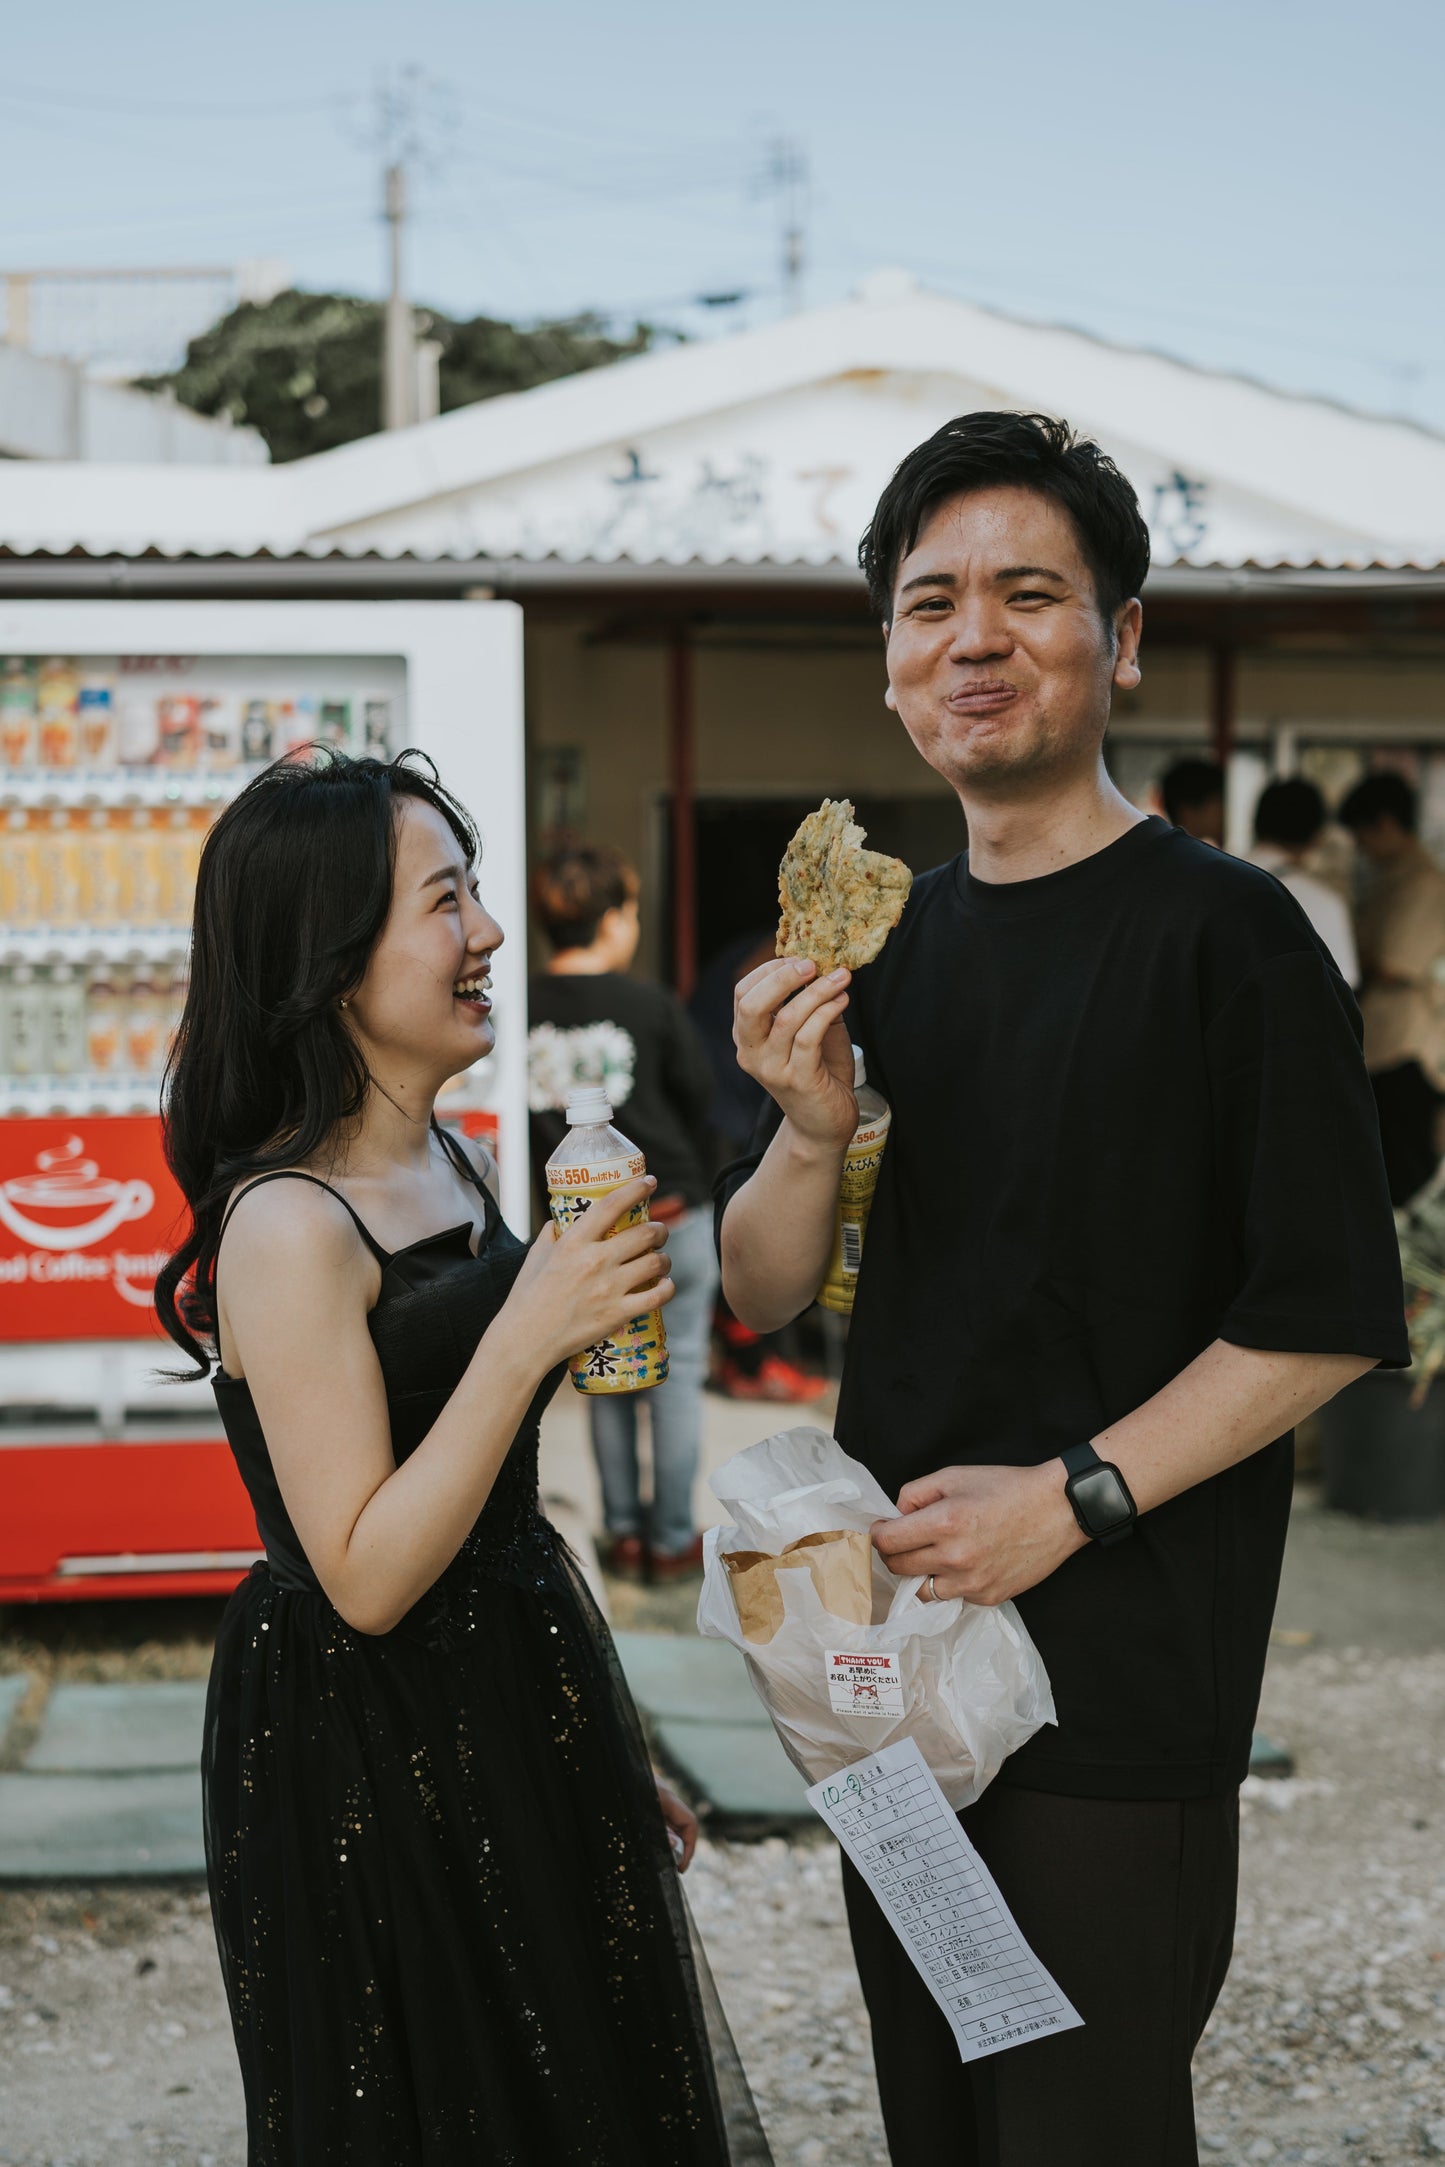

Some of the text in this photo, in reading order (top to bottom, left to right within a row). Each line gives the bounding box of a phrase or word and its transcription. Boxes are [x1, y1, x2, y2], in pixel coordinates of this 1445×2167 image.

[841, 1656, 865, 1665] THANK
[830, 1674, 898, 1683] お召し上がりください
[957, 1996, 972, 2009] 名前
[978, 2014, 1010, 2032] 合計
